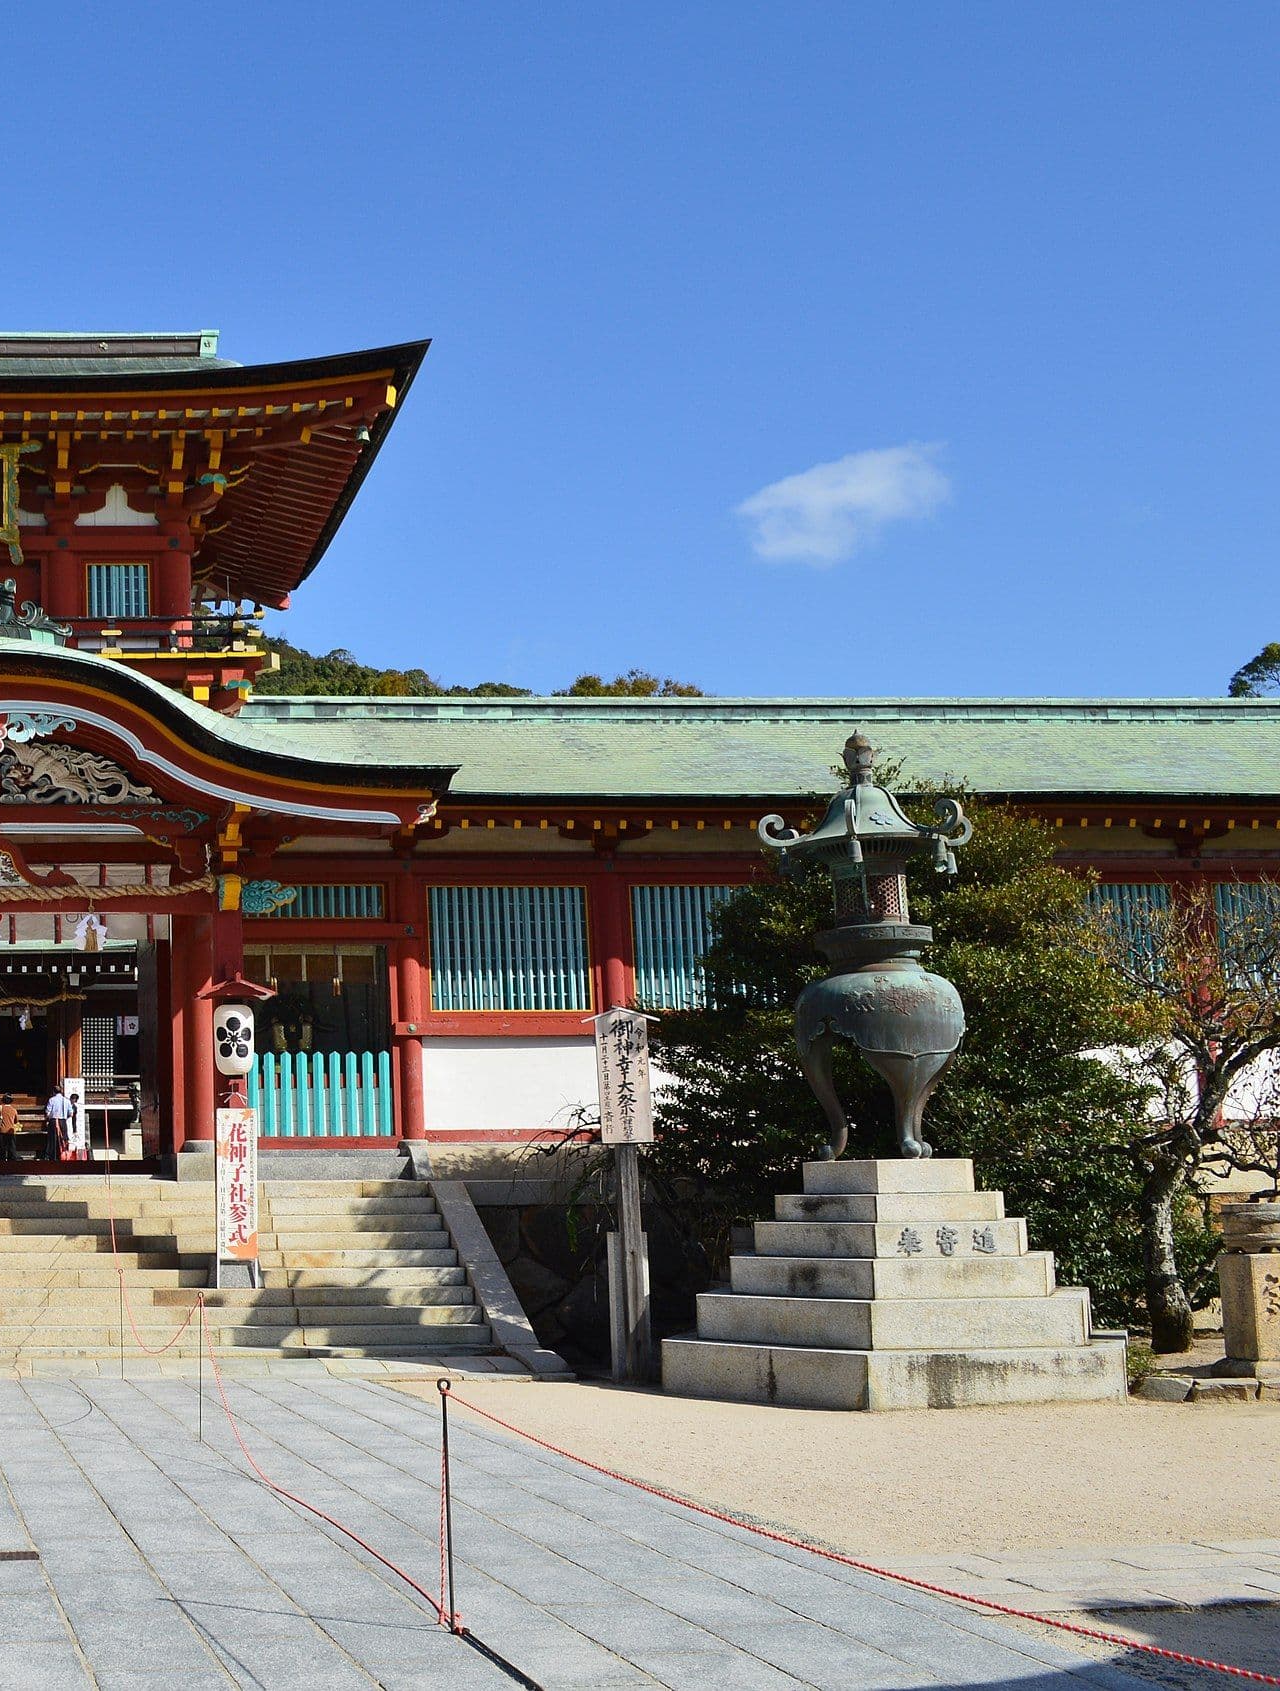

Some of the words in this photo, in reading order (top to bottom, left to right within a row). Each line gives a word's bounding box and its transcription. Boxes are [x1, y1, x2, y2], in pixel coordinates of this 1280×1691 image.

[634, 1027, 646, 1079] 令和元年
[228, 1123, 247, 1244] 花神子社参式
